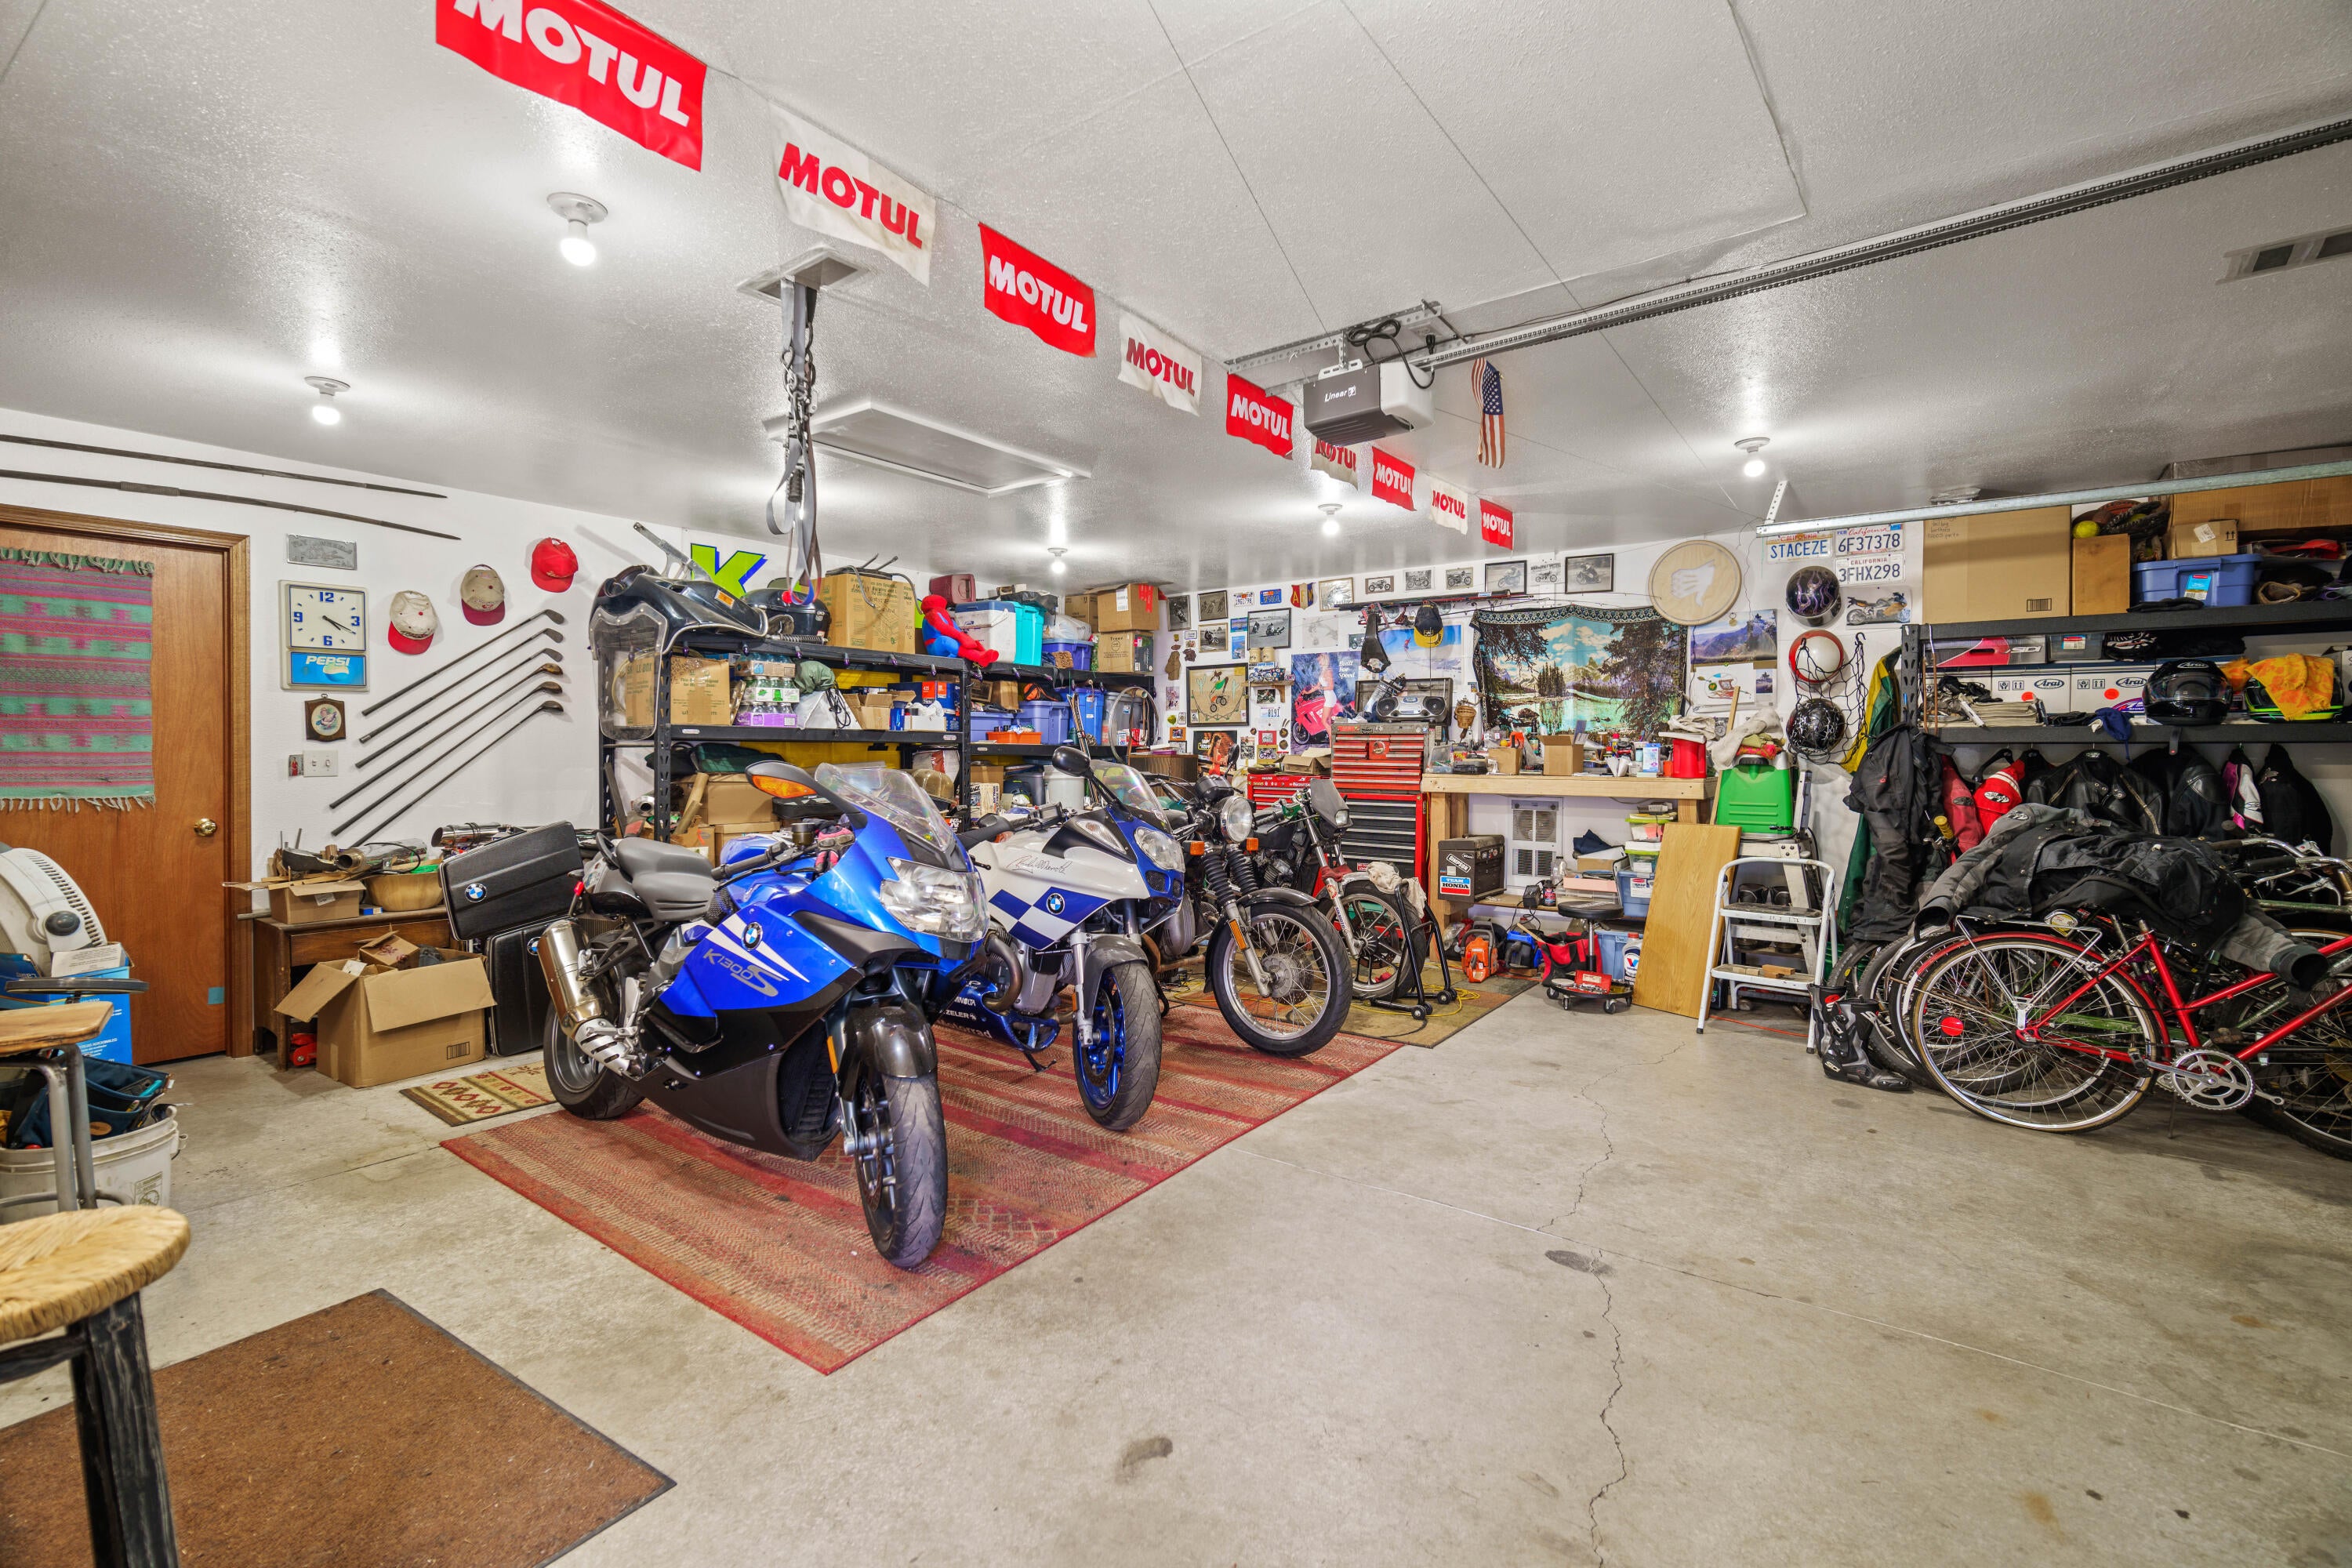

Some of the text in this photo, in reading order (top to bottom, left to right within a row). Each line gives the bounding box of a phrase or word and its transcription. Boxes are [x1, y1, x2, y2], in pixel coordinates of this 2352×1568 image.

[454, 0, 689, 127] MOTUL
[779, 142, 923, 249] MOTUL
[989, 255, 1088, 333] MOTUL
[1126, 337, 1196, 397] MOTUL
[1324, 389, 1348, 402] Linear
[1231, 394, 1290, 441] MOTUL
[1432, 489, 1466, 519] MOTUL
[1483, 512, 1511, 537] MOTUL
[1770, 539, 1828, 559] STACEZE
[1838, 533, 1900, 553] 6F37378
[1838, 564, 1900, 583] 3FHX298
[319, 592, 334, 602] 12
[293, 612, 303, 622] 9
[351, 616, 360, 626] 3
[323, 636, 332, 646] 6
[306, 655, 350, 666] PEPSI
[2039, 680, 2063, 688] Arai
[2119, 678, 2144, 687] Arai
[1448, 855, 1469, 871] SIMPSON
[702, 948, 783, 997] K1300S
[946, 1009, 970, 1018] ZELER
